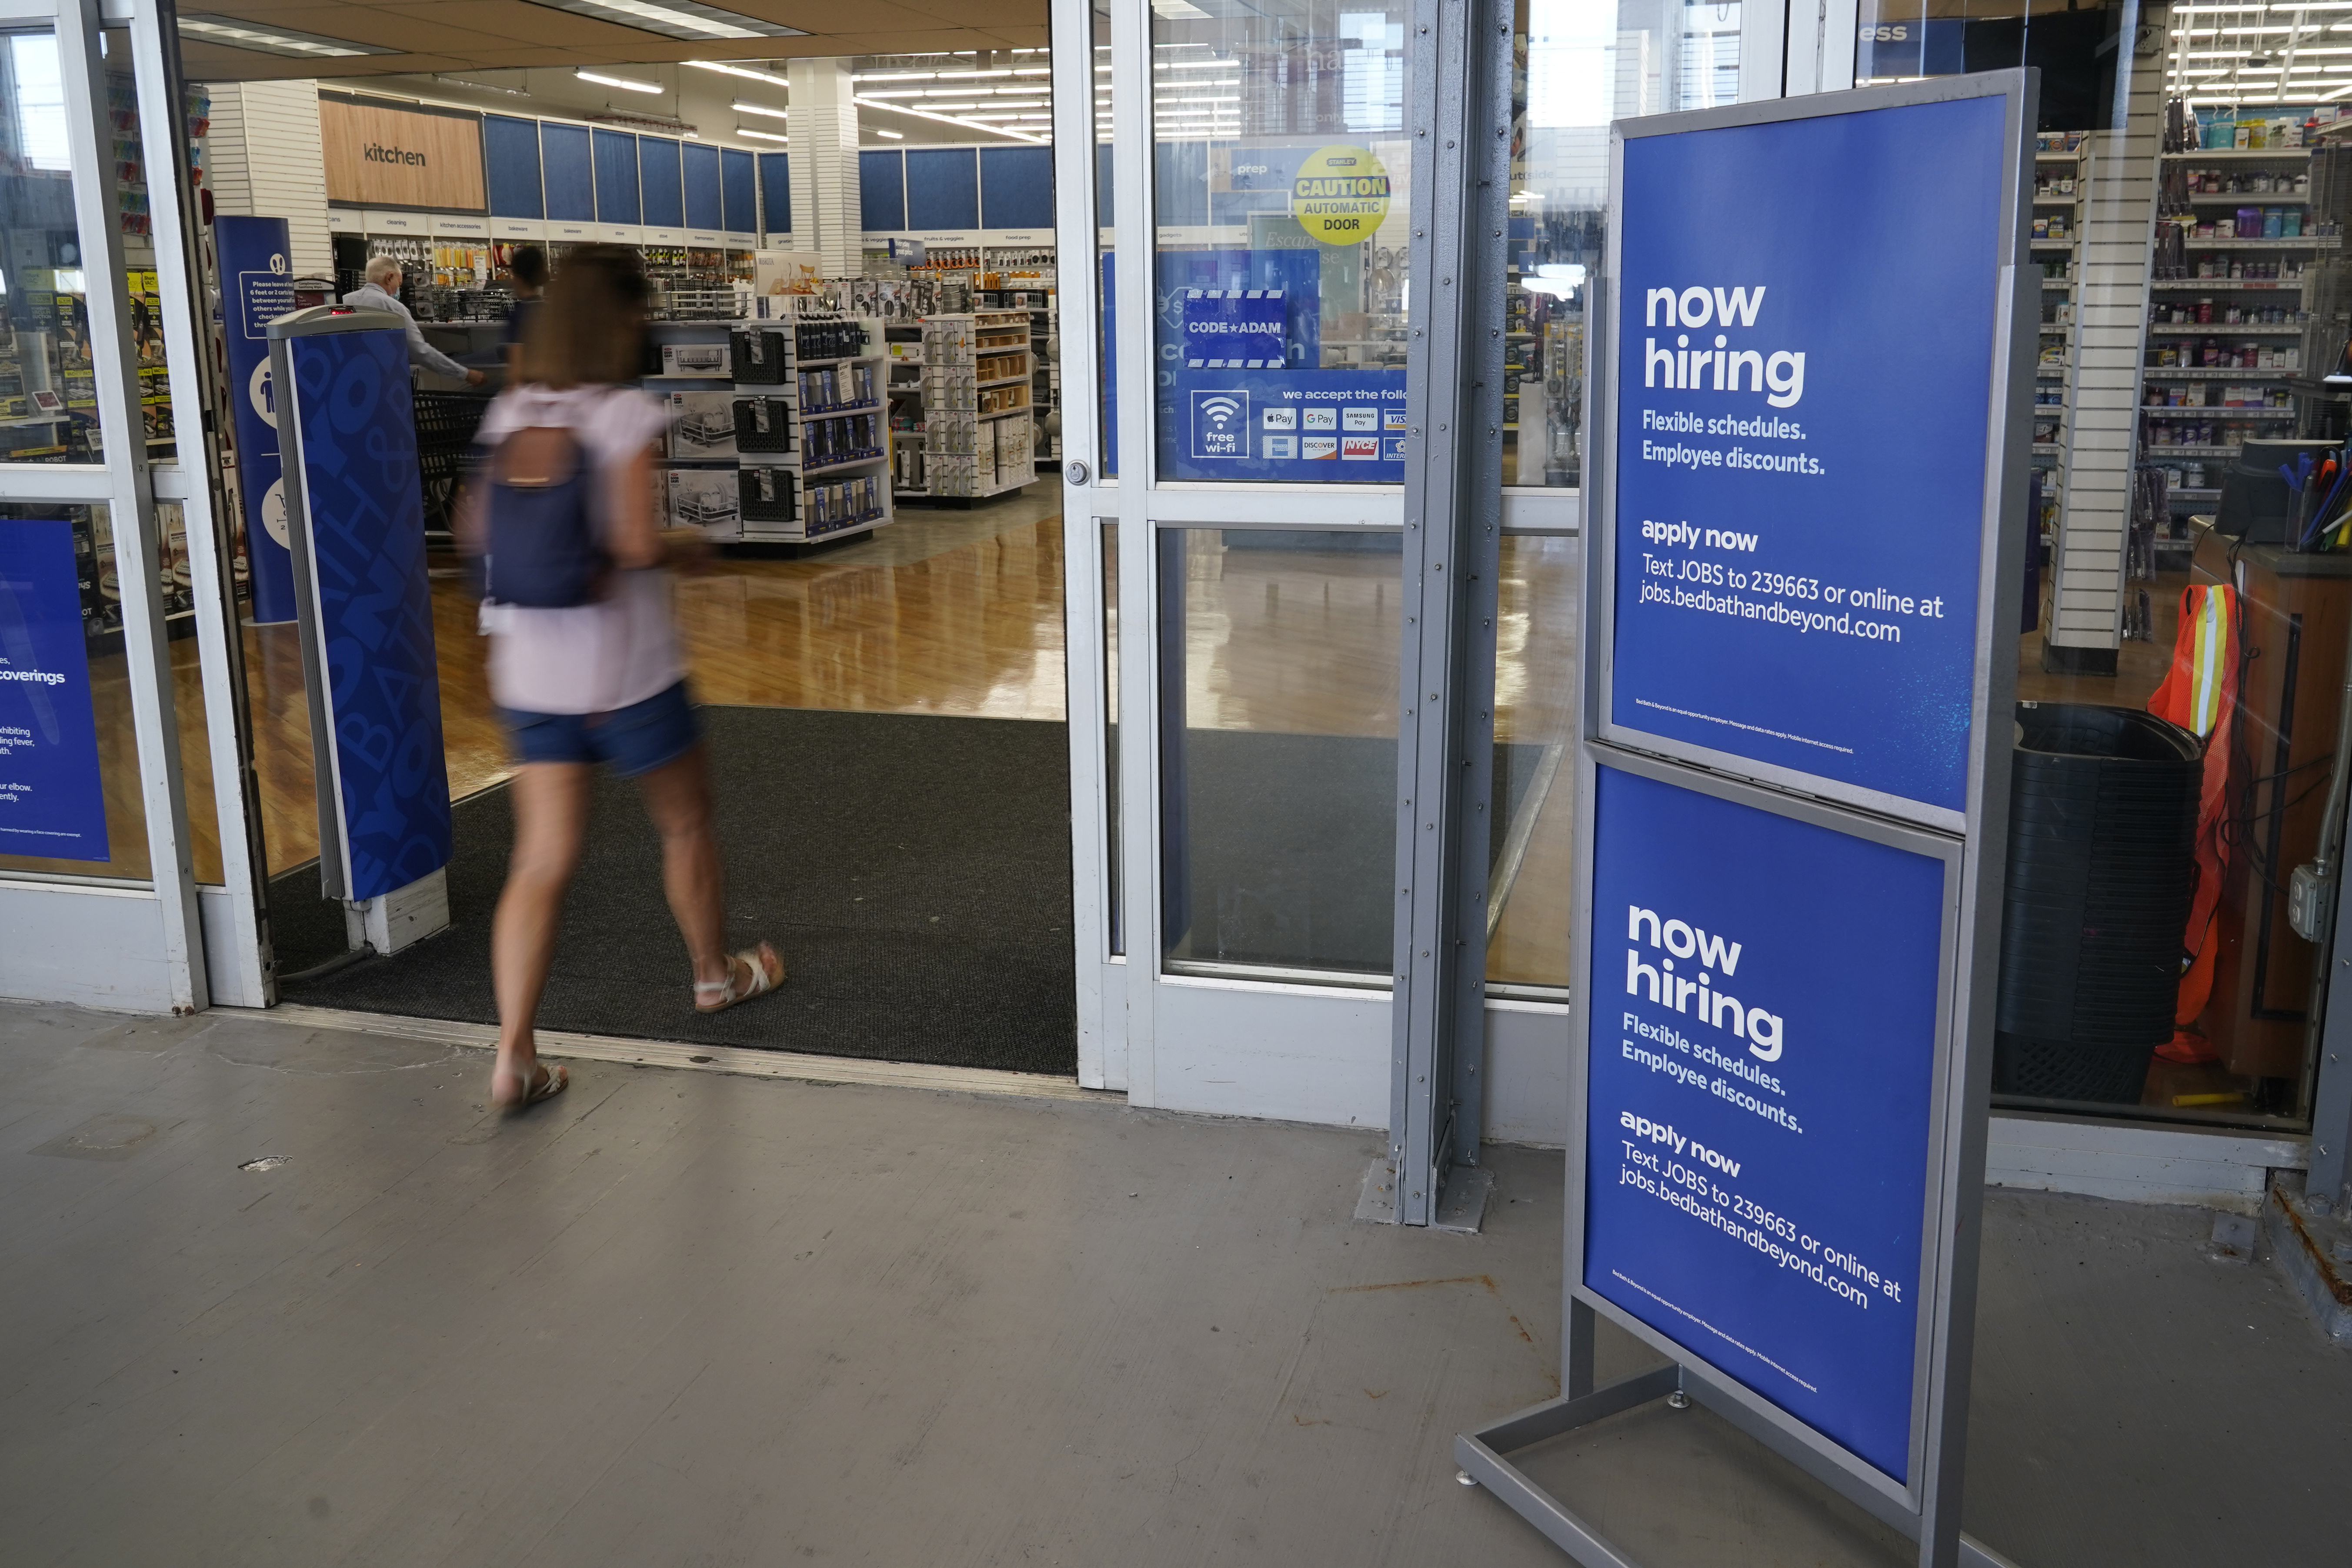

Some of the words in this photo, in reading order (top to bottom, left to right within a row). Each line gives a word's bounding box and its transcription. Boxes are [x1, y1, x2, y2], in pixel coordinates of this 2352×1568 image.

[364, 143, 426, 167] kitchen
[1238, 165, 1267, 175] prep
[1296, 178, 1386, 197] CAUTION
[1304, 202, 1380, 214] AUTOMATIC
[1324, 219, 1360, 230] DOOR
[1265, 232, 1321, 250] Escape
[1646, 286, 1766, 328] now
[1189, 321, 1228, 333] CODE
[1238, 322, 1281, 334] ADAM
[1645, 334, 1805, 408] hiring
[1283, 391, 1302, 400] we
[1304, 390, 1353, 401] accept
[1355, 390, 1378, 400] the
[1276, 414, 1293, 425] Pay
[1306, 414, 1315, 424] G
[1318, 414, 1334, 426] Pay
[1391, 415, 1406, 424] VIS
[1643, 409, 1704, 433] Flexible
[1707, 414, 1806, 440] schedules.
[1205, 443, 1235, 453] wi-fi
[1206, 432, 1234, 442] free
[1346, 440, 1376, 450] NYCE
[1643, 440, 1722, 470] Employee
[1726, 447, 1825, 475] discounts.
[1641, 520, 1701, 550] apply
[1705, 528, 1758, 552] now
[1643, 553, 1674, 578] Text
[1676, 559, 1723, 586] JOBS
[1728, 568, 1747, 589] to
[1751, 571, 1818, 601] 239663
[1824, 585, 1845, 604] or
[1850, 587, 1914, 614] online
[1920, 596, 1944, 618] at
[1639, 580, 1900, 643] jobs.bedbathandbeyond.com
[13, 737, 35, 747] fever,
[1655, 703, 1668, 711] Beyond
[1688, 711, 1710, 721] opportunity
[1710, 716, 1729, 725] employer.
[1729, 720, 1747, 730] Message
[1788, 733, 1801, 742] Mobile
[1802, 737, 1818, 746] internet
[1819, 741, 1833, 749] access
[1834, 744, 1854, 754] required.
[8, 783, 33, 791] elbow.
[1628, 905, 1742, 976] now
[1627, 948, 1783, 1062] hiring
[1623, 1012, 1689, 1053] Flexible
[1693, 1043, 1785, 1096] schedules.
[1622, 1039, 1707, 1090] Employee
[1711, 1078, 1803, 1134] discounts.
[1620, 1111, 1687, 1154] apply
[1691, 1141, 1741, 1178] now
[1622, 1140, 1659, 1172] Text
[1662, 1159, 1707, 1196] JOBS
[1711, 1184, 1729, 1207] to
[1734, 1195, 1796, 1242] 239663
[1801, 1234, 1821, 1254] or
[1824, 1246, 1879, 1288] online
[1883, 1279, 1901, 1303] at
[1619, 1164, 1868, 1309] jobs.bedbathandbeyond.com
[1631, 1280, 1643, 1291] Beyond
[1651, 1293, 1661, 1301] equal
[1661, 1299, 1683, 1314] opportunity
[1683, 1311, 1701, 1324] employer.
[1701, 1320, 1718, 1334] Message
[1725, 1334, 1734, 1343] data
[1735, 1341, 1745, 1349] rates
[1745, 1346, 1757, 1356] apply.
[1757, 1352, 1770, 1364] Mobile
[1770, 1360, 1785, 1374] internet
[1785, 1371, 1798, 1382] access
[1798, 1379, 1817, 1393] required.
